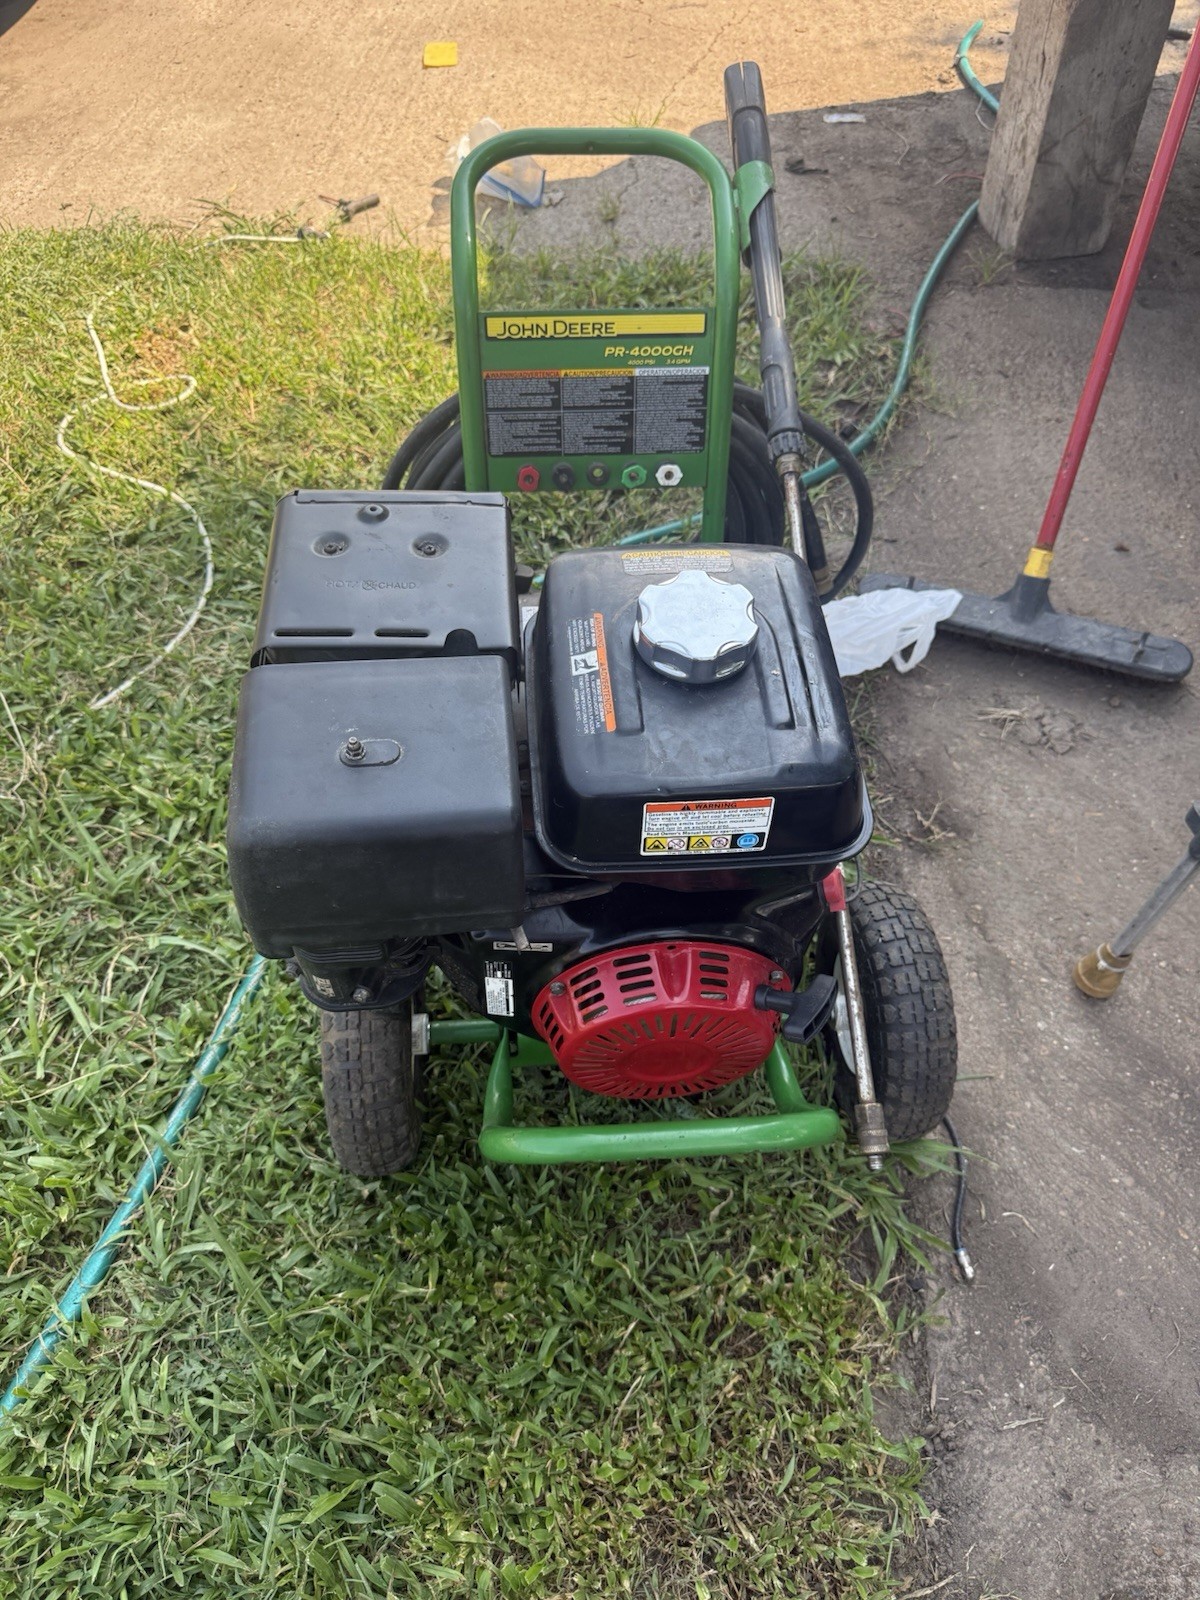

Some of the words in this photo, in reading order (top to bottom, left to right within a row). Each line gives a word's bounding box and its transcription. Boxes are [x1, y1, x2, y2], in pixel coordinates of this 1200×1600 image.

[496, 320, 548, 337] JOHN
[553, 320, 616, 336] DEERE
[604, 346, 694, 358] PR-4000GH
[378, 581, 416, 590] CHAUD
[594, 620, 604, 647] WARNING
[600, 666, 612, 714] ADVERTENCIA
